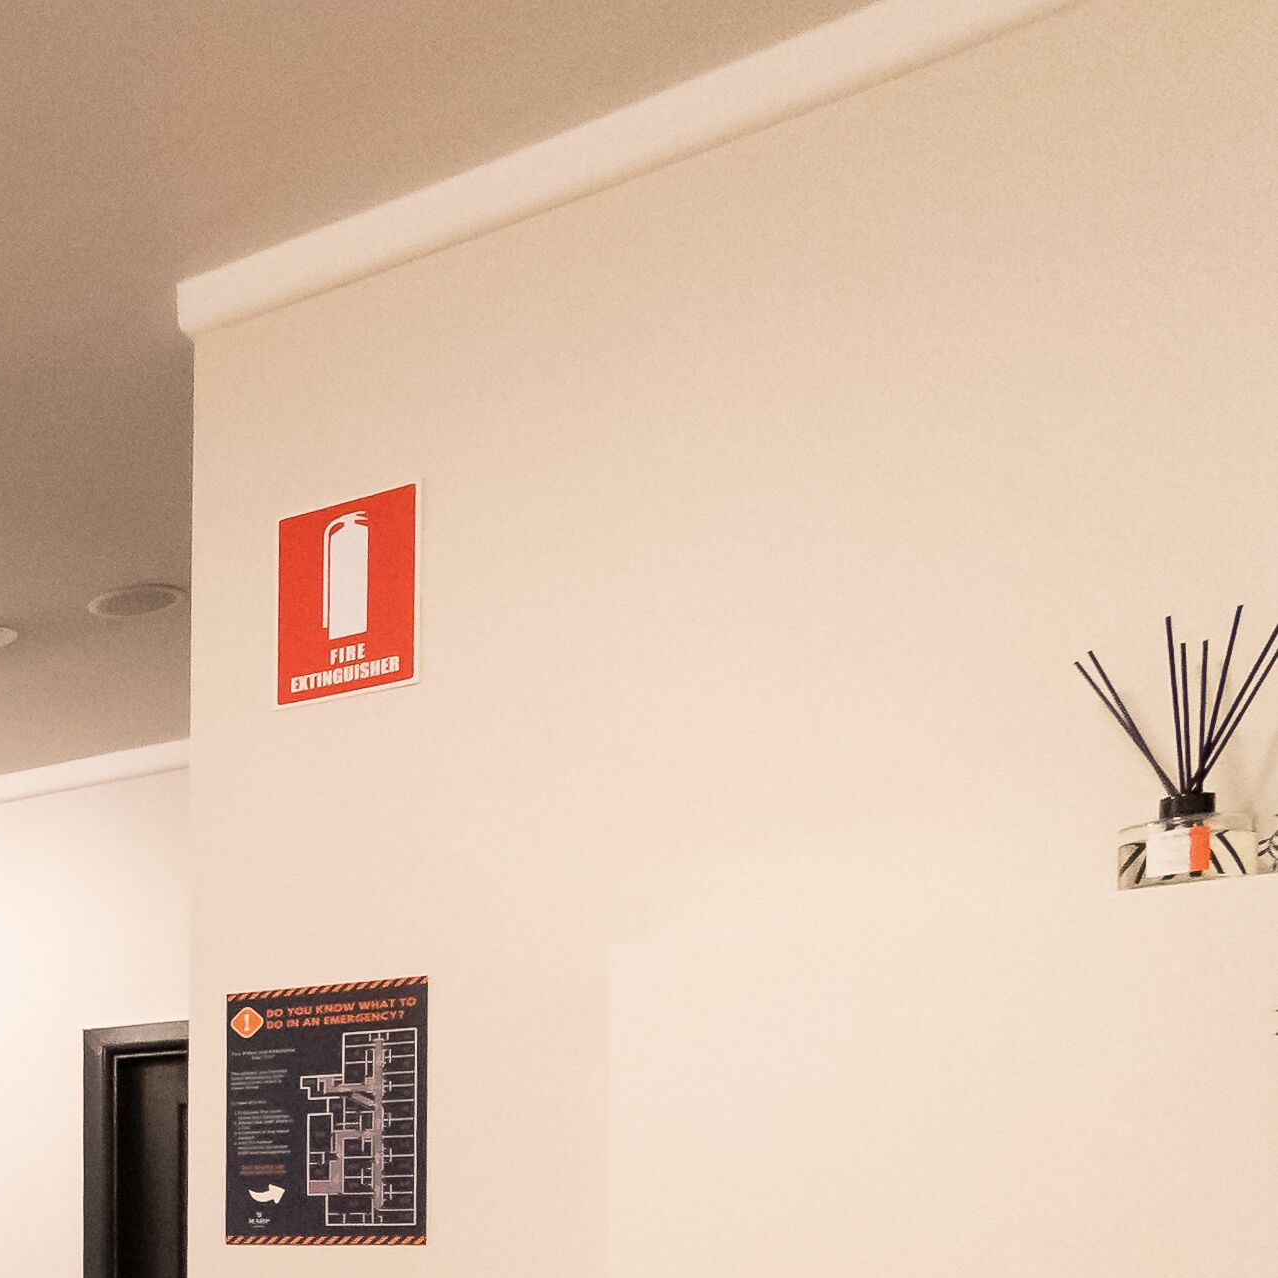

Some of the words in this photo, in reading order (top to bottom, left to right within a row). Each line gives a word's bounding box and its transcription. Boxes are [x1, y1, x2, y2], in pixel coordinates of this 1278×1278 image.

[330, 643, 366, 665] FIRE
[290, 655, 400, 693] EXTINGUISHER
[266, 1008, 283, 1018] DO
[287, 1006, 312, 1016] YOU
[316, 1002, 355, 1015] KNOW
[358, 998, 396, 1011] WHAT
[399, 996, 417, 1007] TO
[266, 1020, 283, 1029] DO
[287, 1019, 300, 1028] IN
[302, 1017, 320, 1027] AN
[324, 1010, 405, 1025] EMERGENCY?
